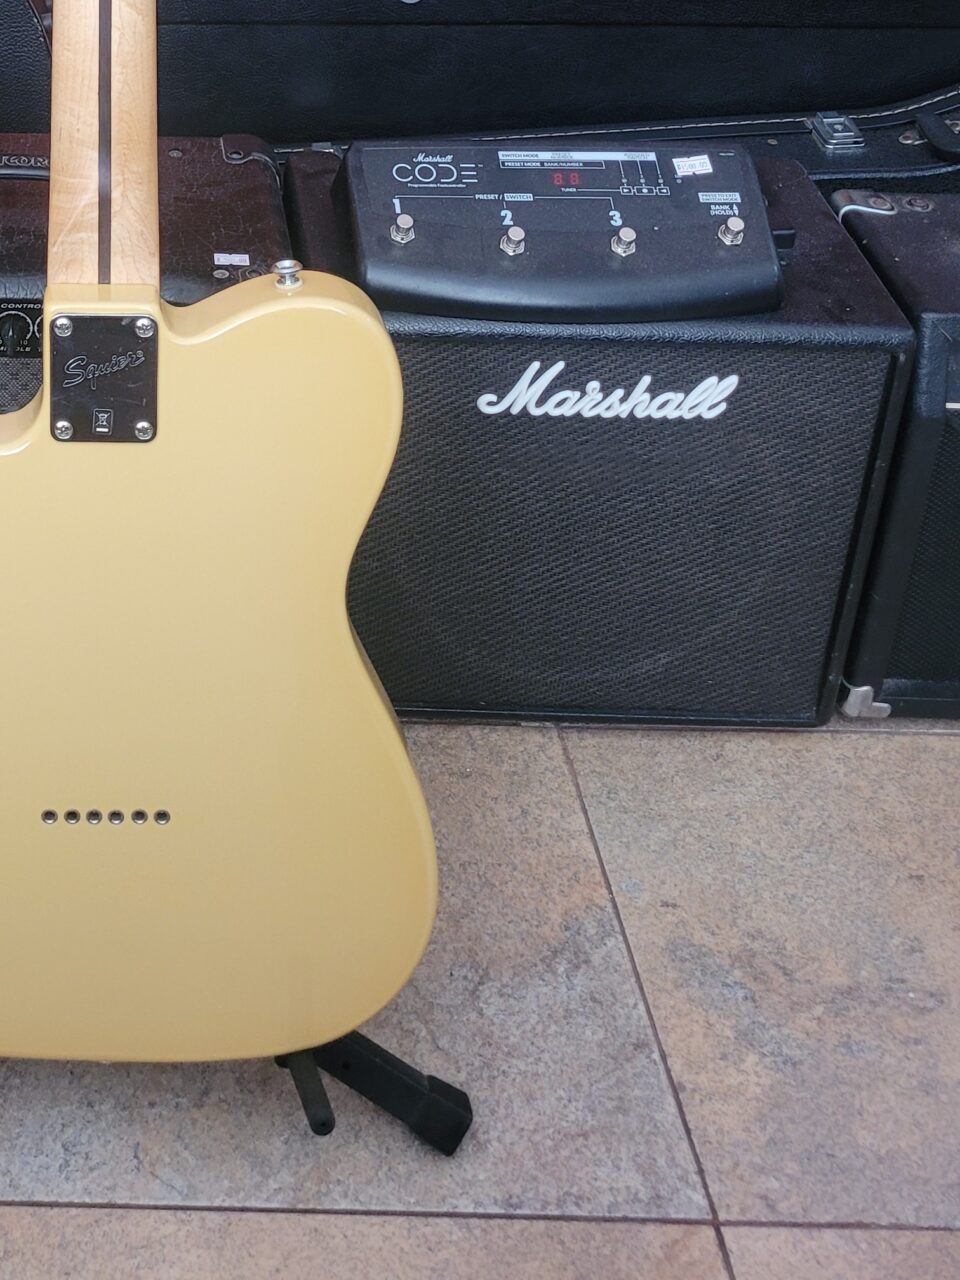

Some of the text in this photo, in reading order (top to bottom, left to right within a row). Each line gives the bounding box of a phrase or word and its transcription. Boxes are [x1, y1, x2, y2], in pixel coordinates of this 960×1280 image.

[412, 152, 454, 163] Marshall
[392, 163, 478, 182] CODE
[392, 199, 401, 214] 1
[500, 209, 514, 225] 2
[609, 210, 623, 226] 3
[62, 350, 145, 390] Squier
[476, 360, 739, 420] Marshall
